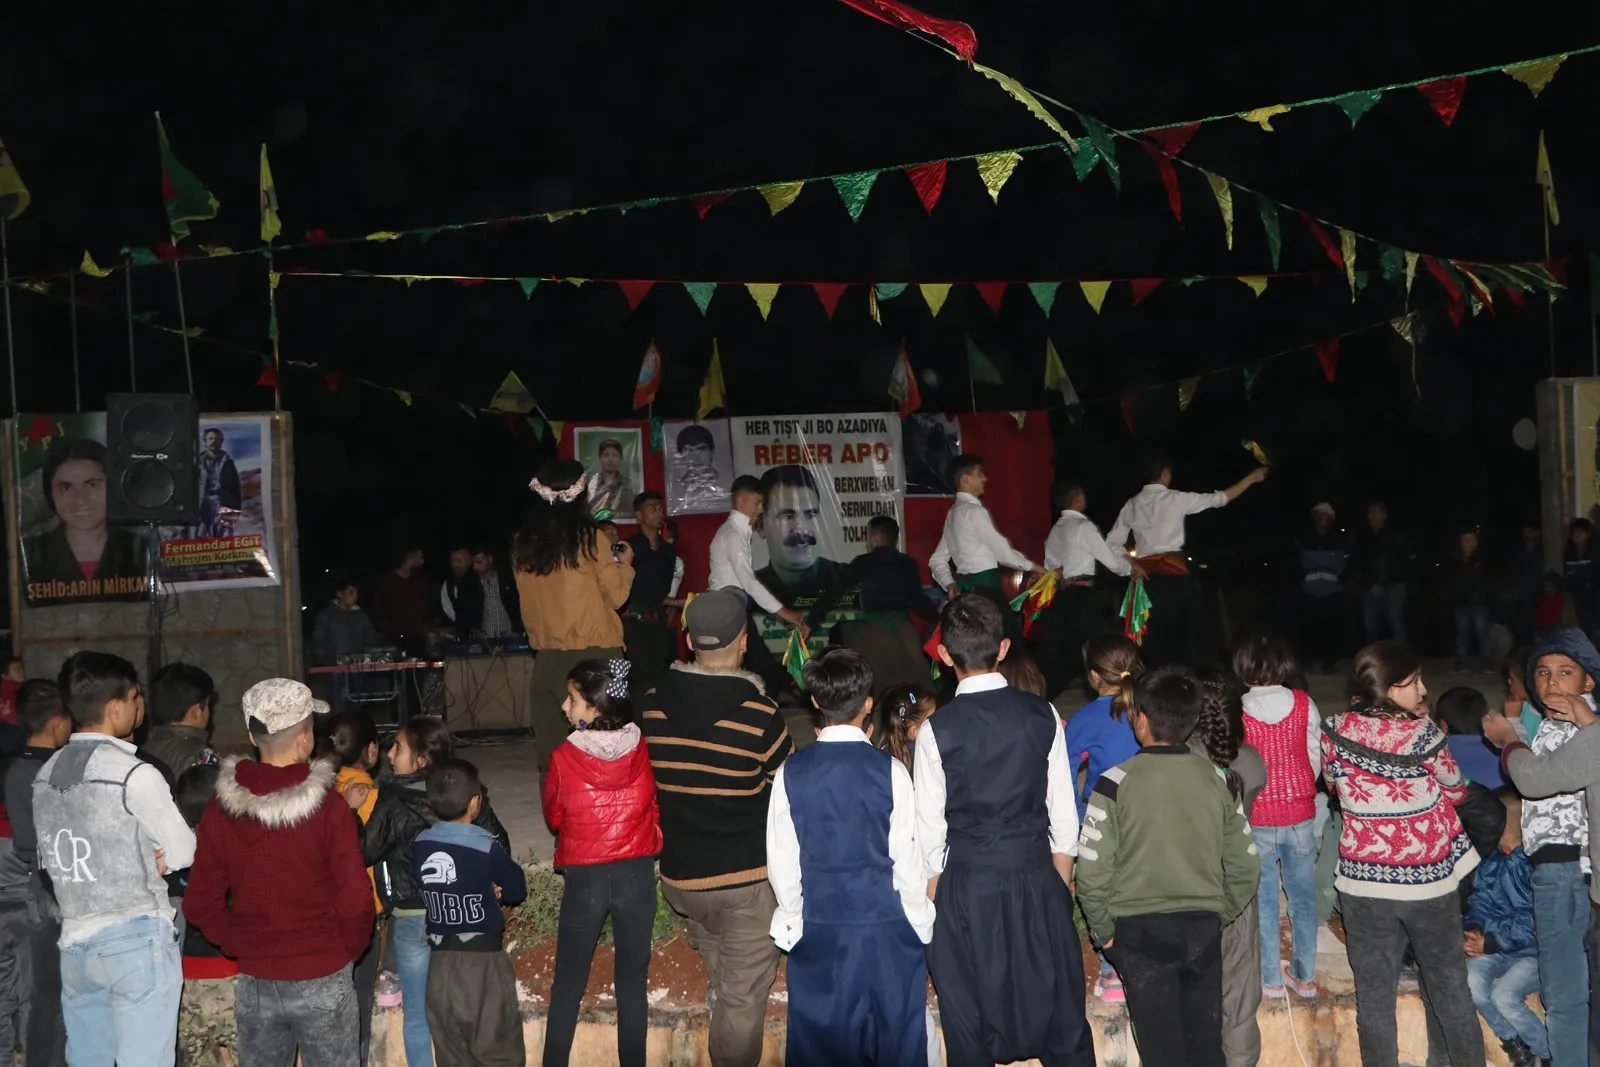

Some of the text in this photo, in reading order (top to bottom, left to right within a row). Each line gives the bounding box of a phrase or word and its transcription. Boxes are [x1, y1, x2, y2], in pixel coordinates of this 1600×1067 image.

[745, 420, 770, 435] HER
[773, 419, 799, 438] TIŞT
[803, 419, 813, 434] JI
[817, 419, 833, 433] BO
[754, 438, 890, 465] RÊBER APO
[843, 525, 868, 543] TOLH
[165, 539, 231, 553] Fermandar
[215, 549, 256, 560] Korkma
[420, 888, 485, 925] UBG
